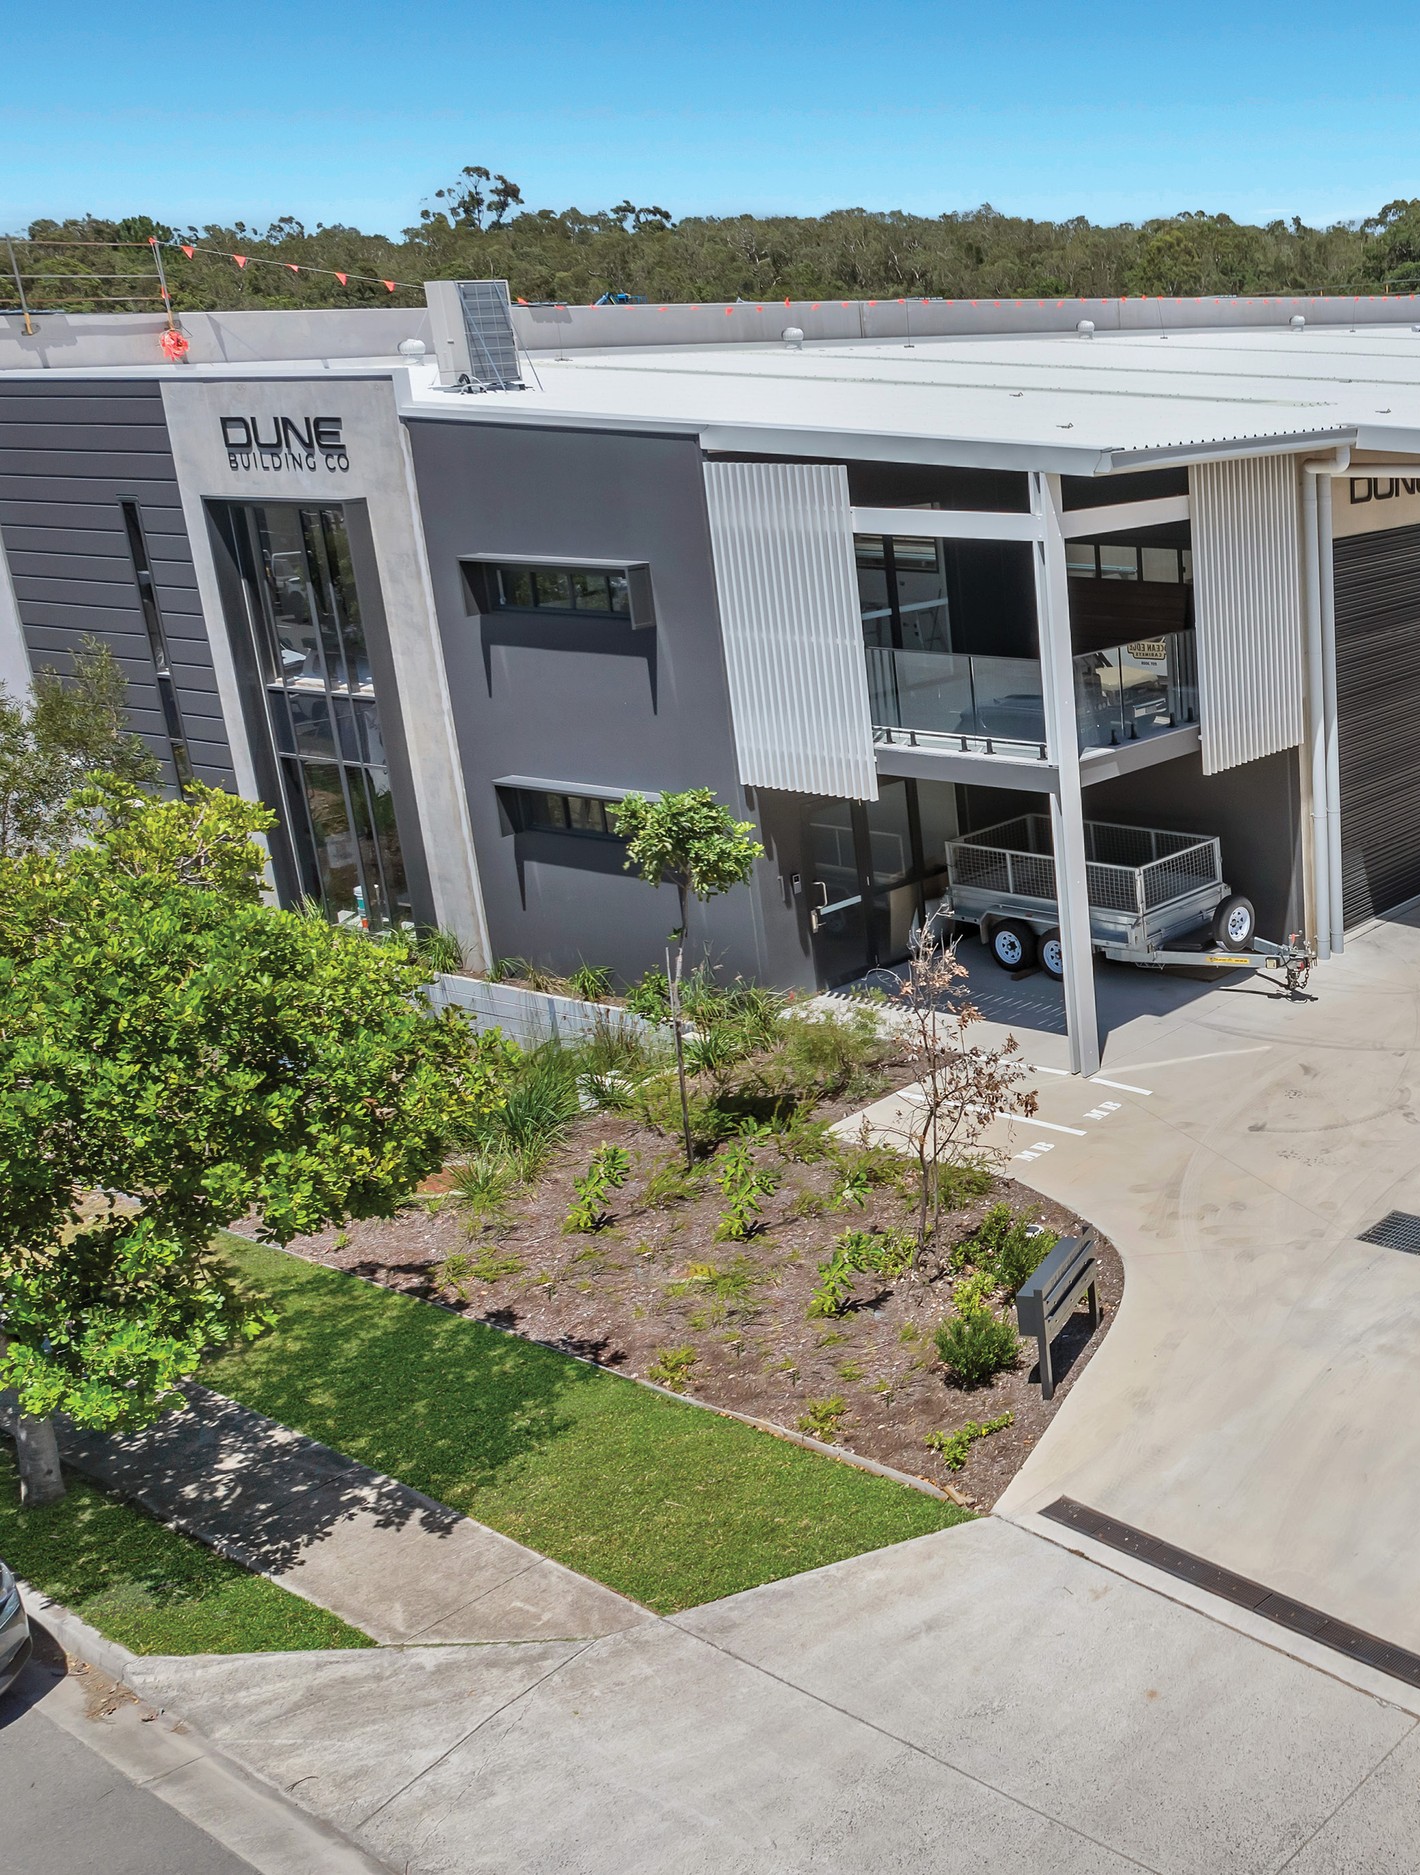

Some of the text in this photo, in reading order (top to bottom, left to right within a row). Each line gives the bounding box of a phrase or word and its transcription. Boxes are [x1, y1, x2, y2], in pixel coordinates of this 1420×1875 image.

[219, 416, 346, 449] DUNE
[228, 452, 350, 471] BUILDING CO
[1082, 1100, 1122, 1120] MB
[1013, 1141, 1056, 1162] MB
